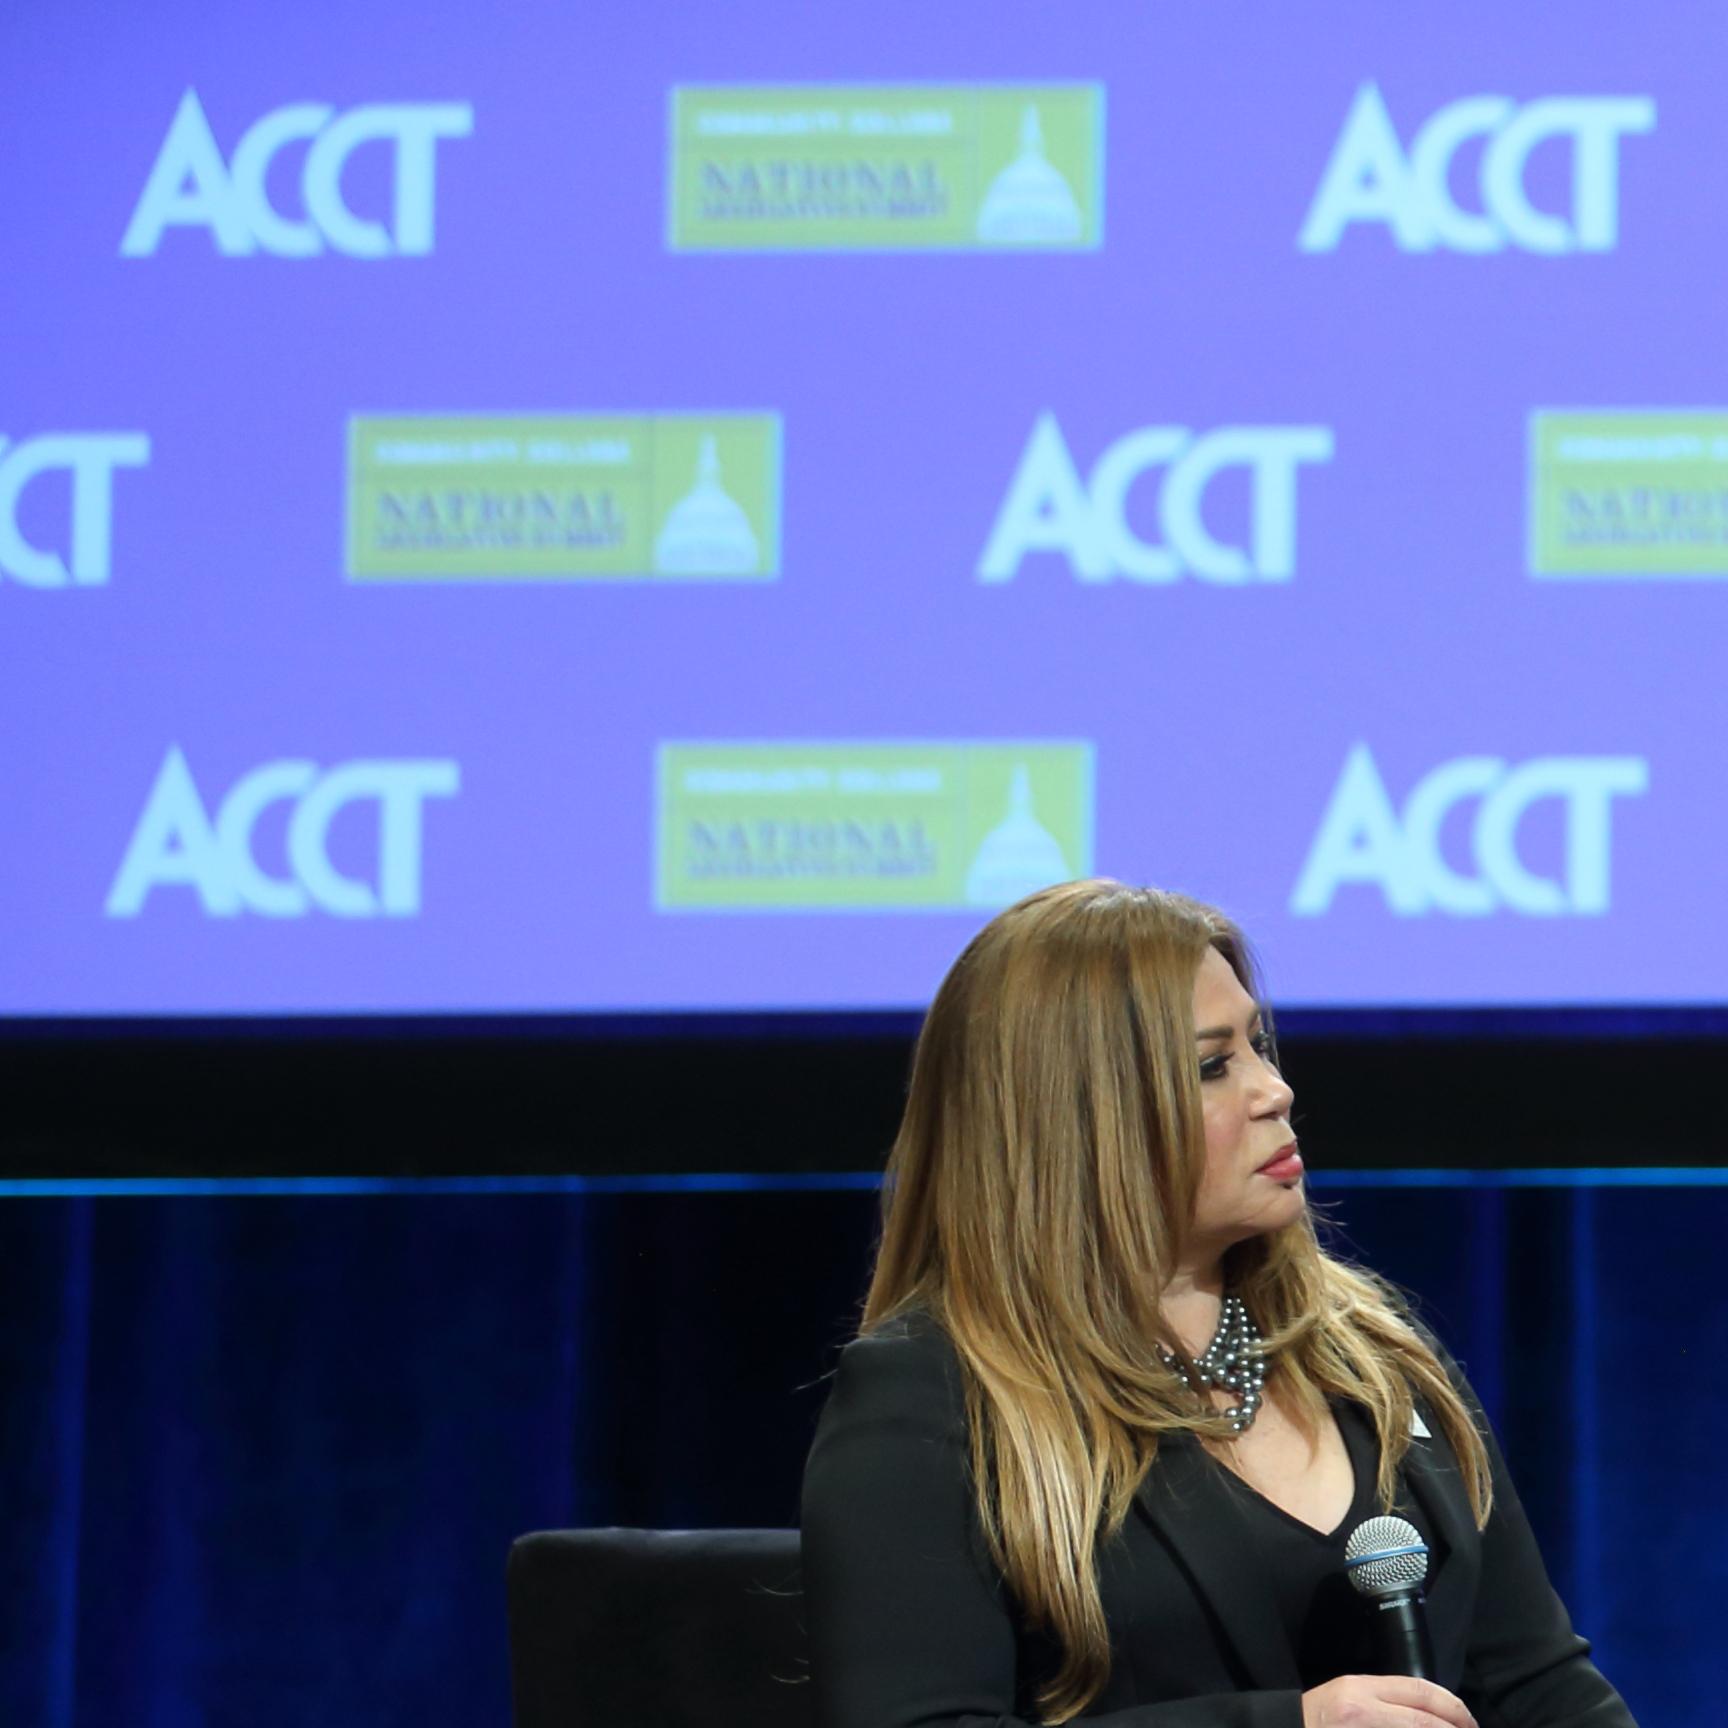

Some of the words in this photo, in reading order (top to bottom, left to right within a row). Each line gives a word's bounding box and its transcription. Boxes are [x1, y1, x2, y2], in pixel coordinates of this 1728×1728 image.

[120, 86, 473, 256] ACCT
[1299, 81, 1655, 254] ACCT
[978, 411, 1333, 583] ACCT
[106, 745, 459, 917] ACCT
[1290, 740, 1648, 916] ACCT
